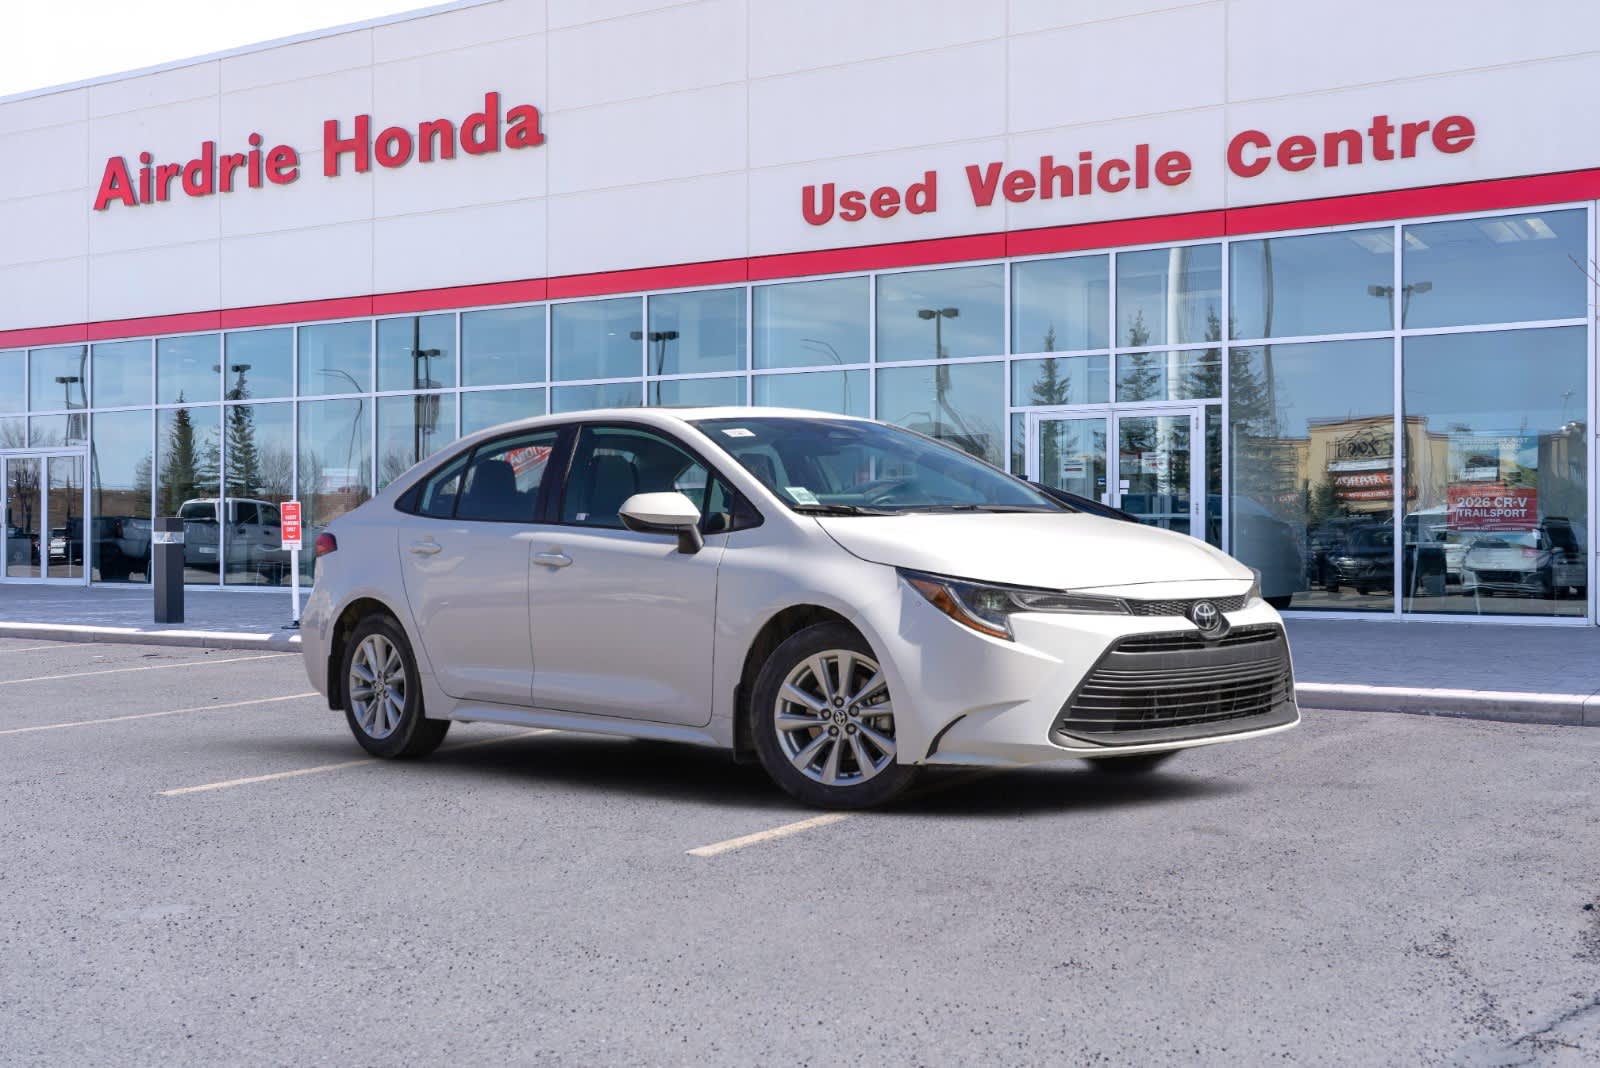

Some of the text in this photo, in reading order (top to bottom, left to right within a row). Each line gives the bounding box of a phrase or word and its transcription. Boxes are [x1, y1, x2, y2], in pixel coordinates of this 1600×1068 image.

[94, 91, 545, 211] Airdrie Honda
[801, 115, 1476, 226] Used Vehicle Centre
[1456, 496, 1528, 508] 2026 CR-V
[1458, 508, 1528, 518] TRAILSPORT
